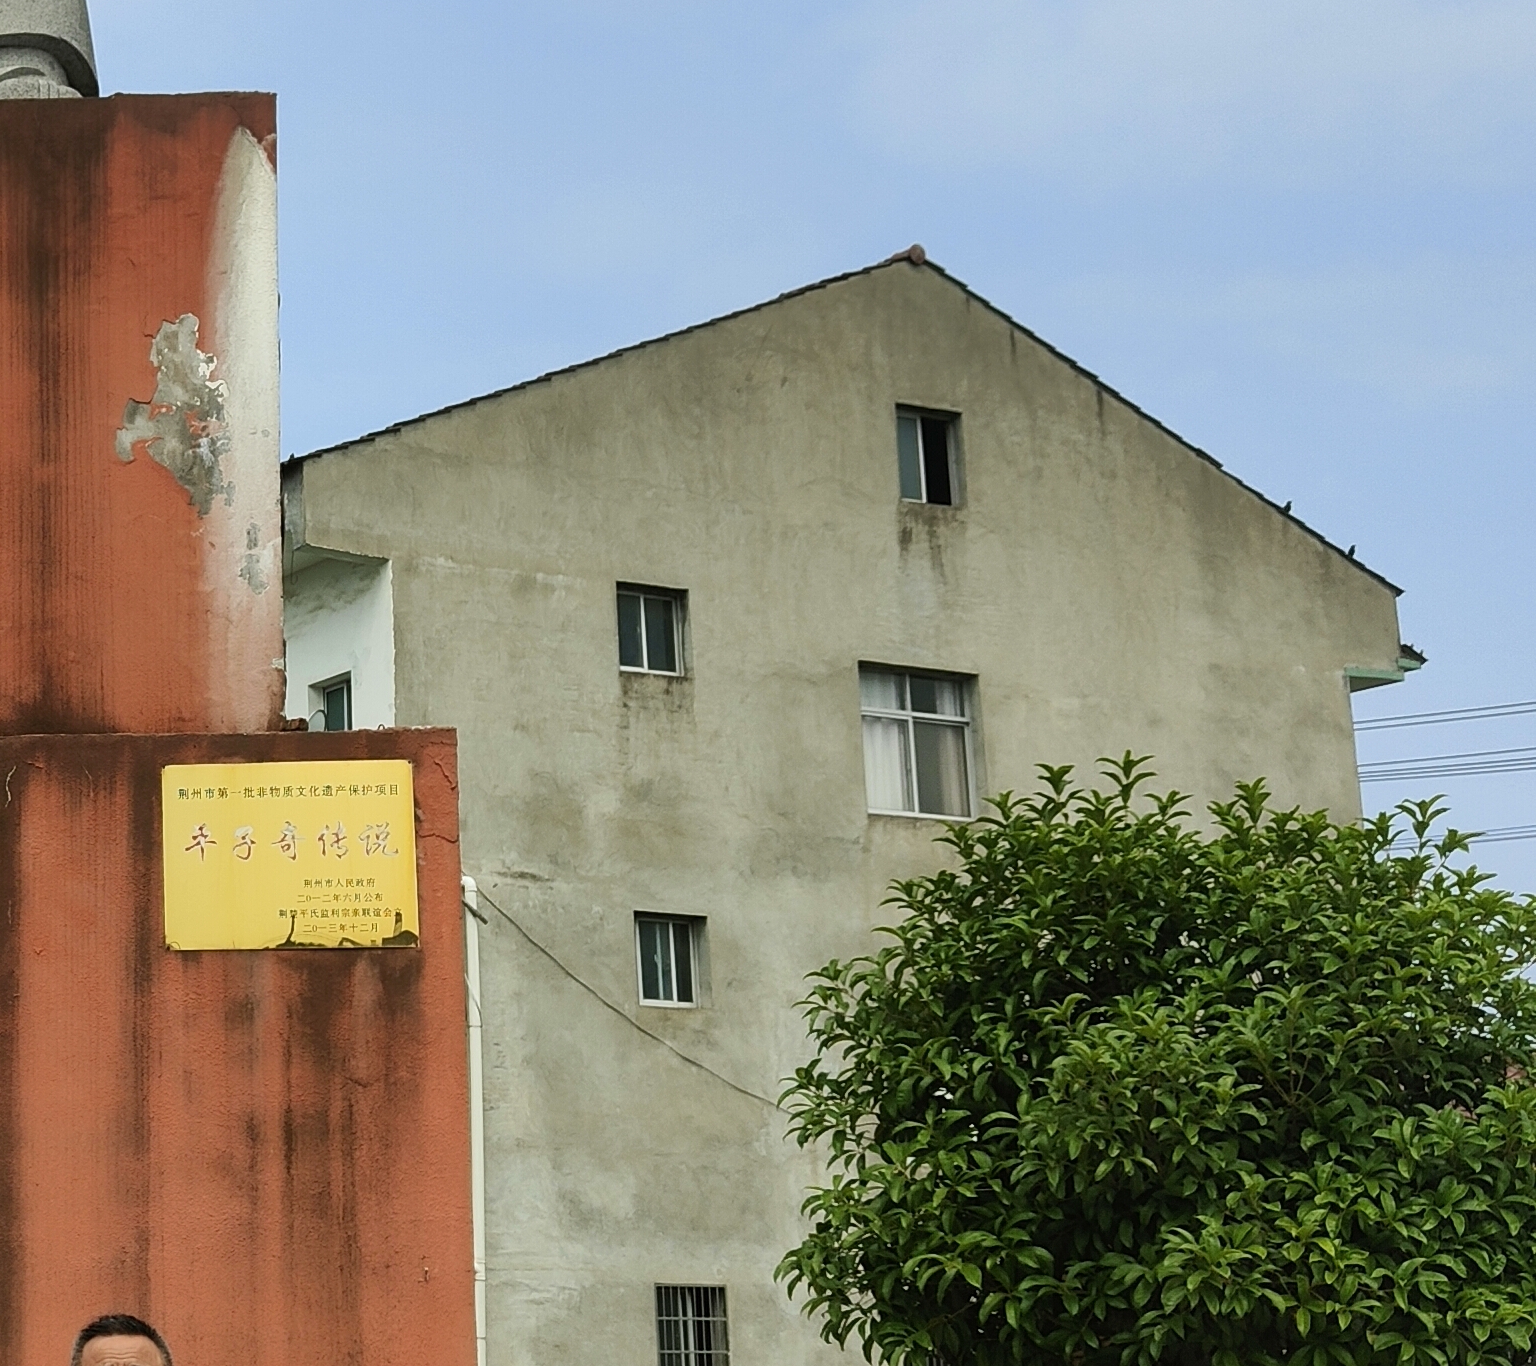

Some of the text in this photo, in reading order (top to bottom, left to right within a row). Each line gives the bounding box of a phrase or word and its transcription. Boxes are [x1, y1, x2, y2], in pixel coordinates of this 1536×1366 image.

[177, 784, 399, 800] 荆州市第一批非物质文化遗产保护项目
[184, 821, 400, 862] 平子奇传说
[303, 878, 376, 889] 荆州市人民政府
